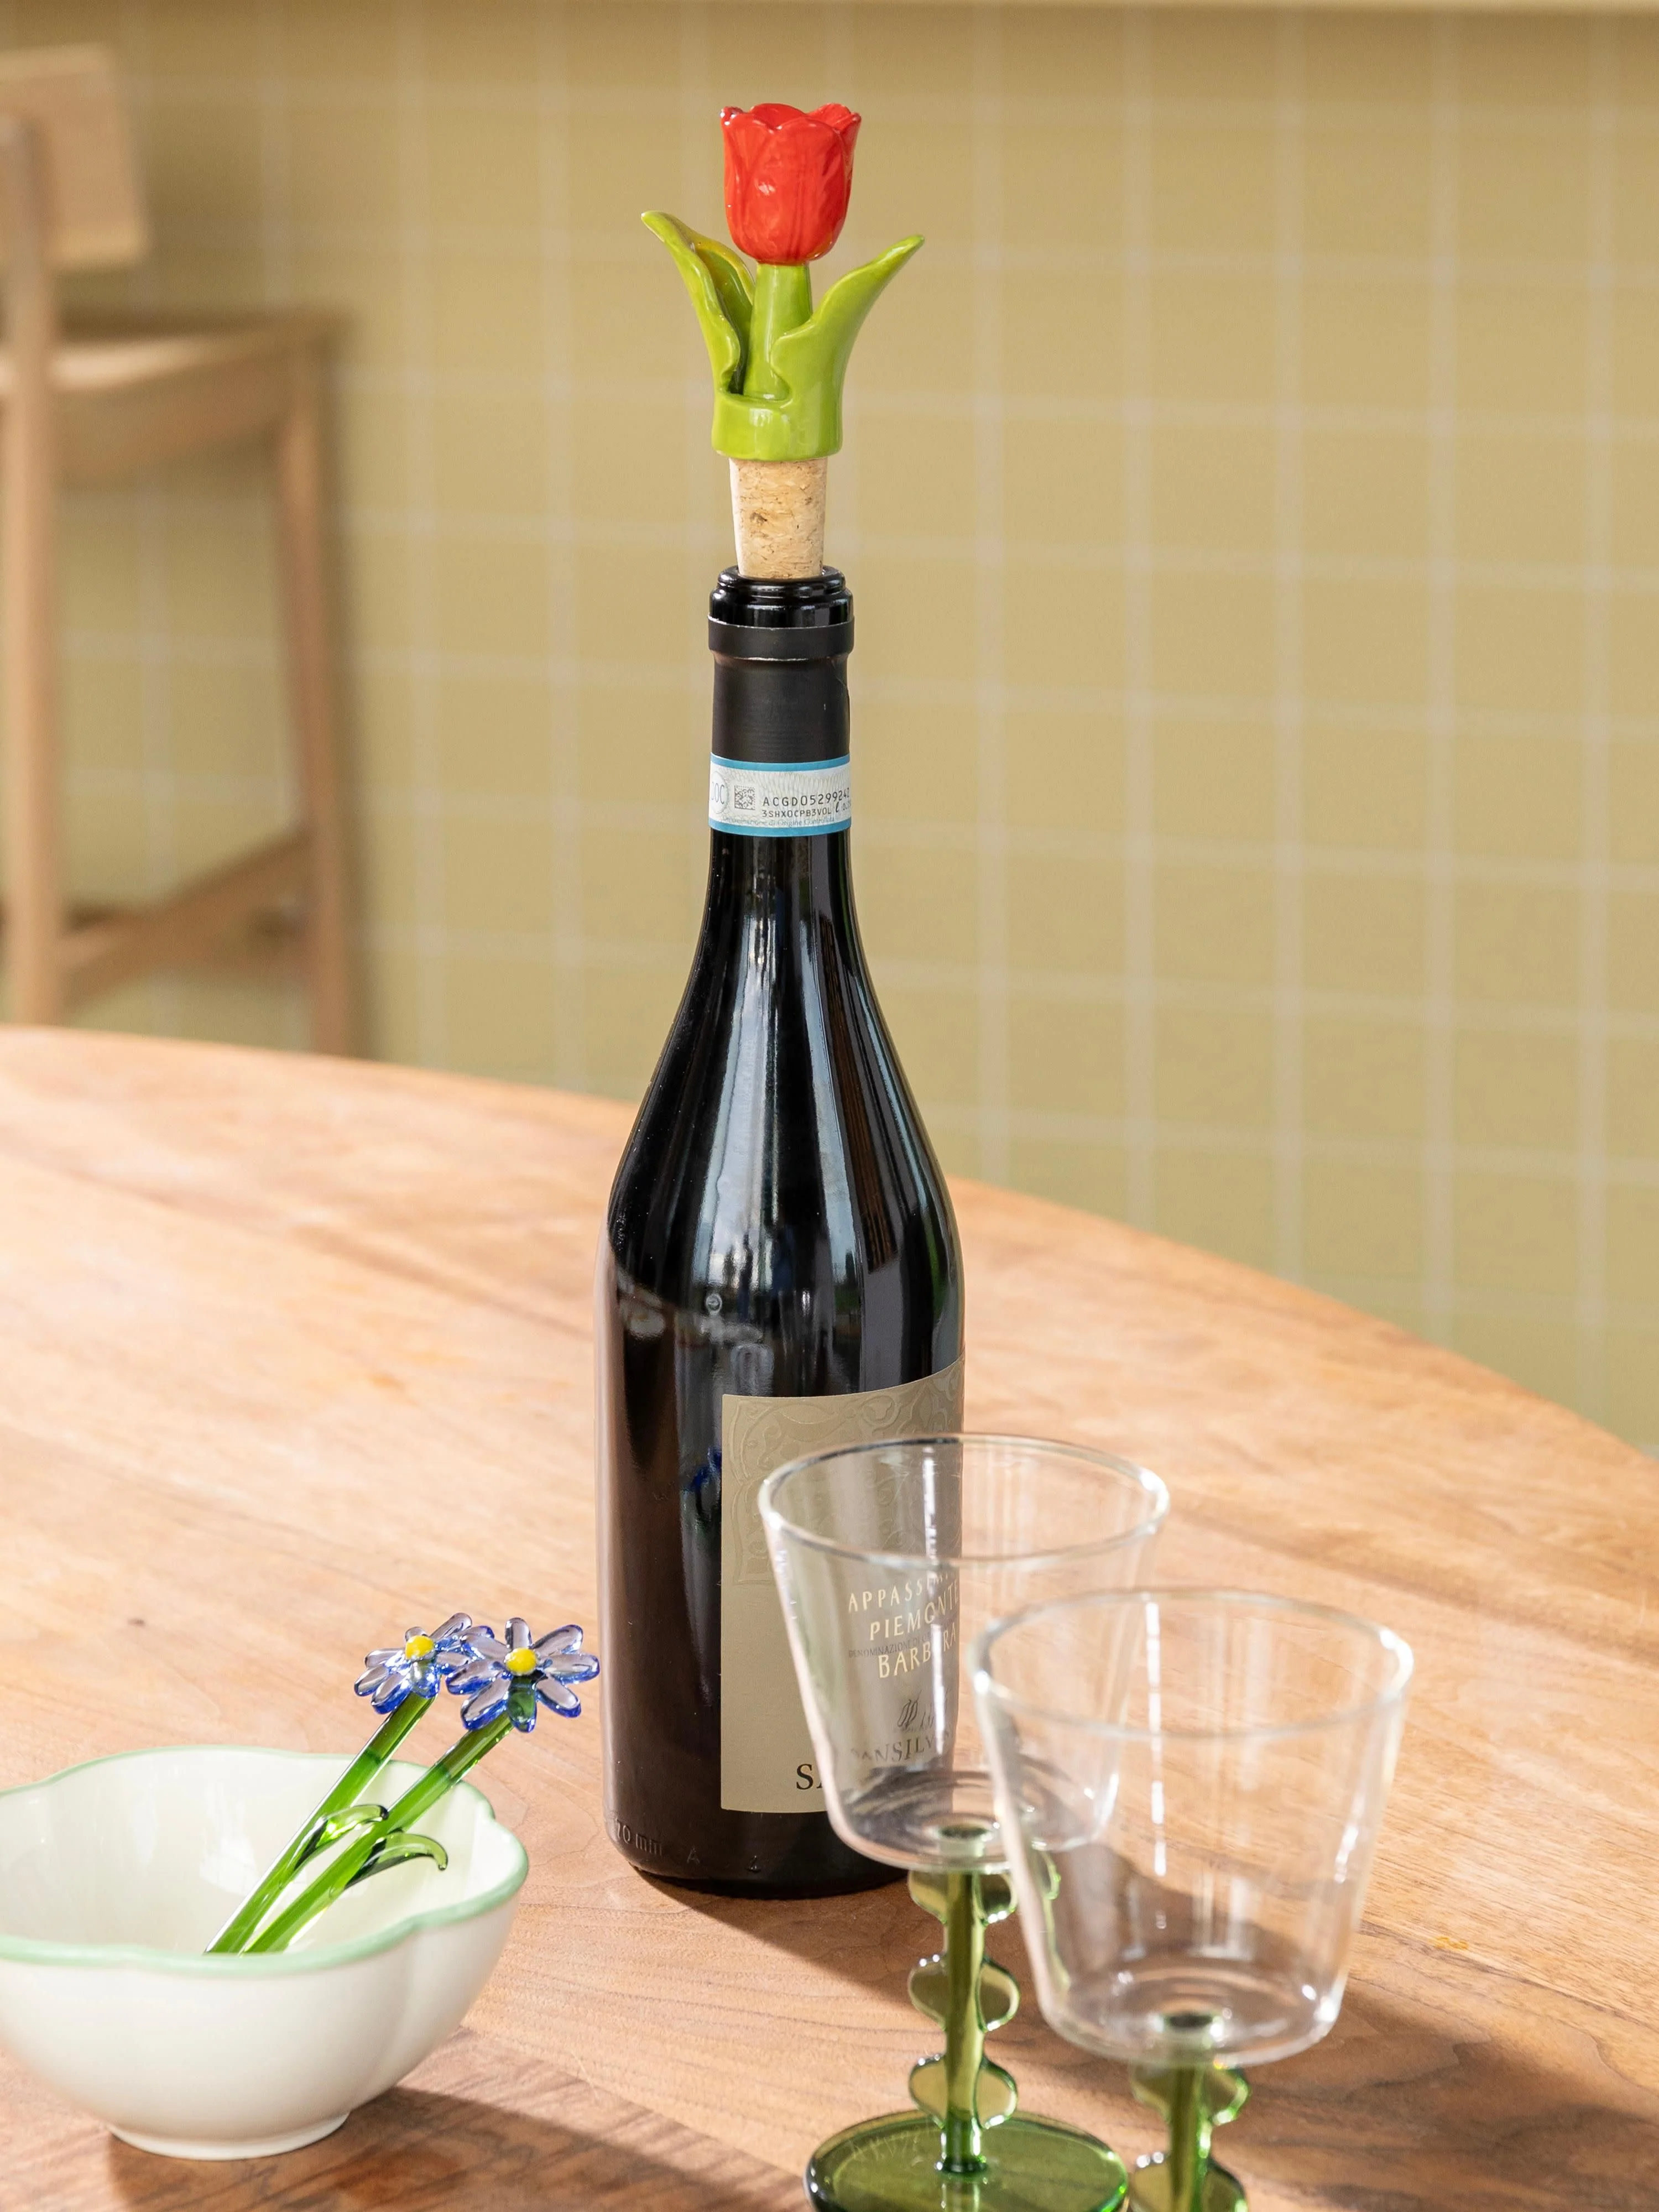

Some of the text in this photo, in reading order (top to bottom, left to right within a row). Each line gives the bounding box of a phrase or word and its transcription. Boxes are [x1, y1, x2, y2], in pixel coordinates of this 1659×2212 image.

[712, 781, 724, 805] OC
[869, 1579, 958, 1641] PIEMONTE
[878, 1623, 956, 1678] BARBRA
